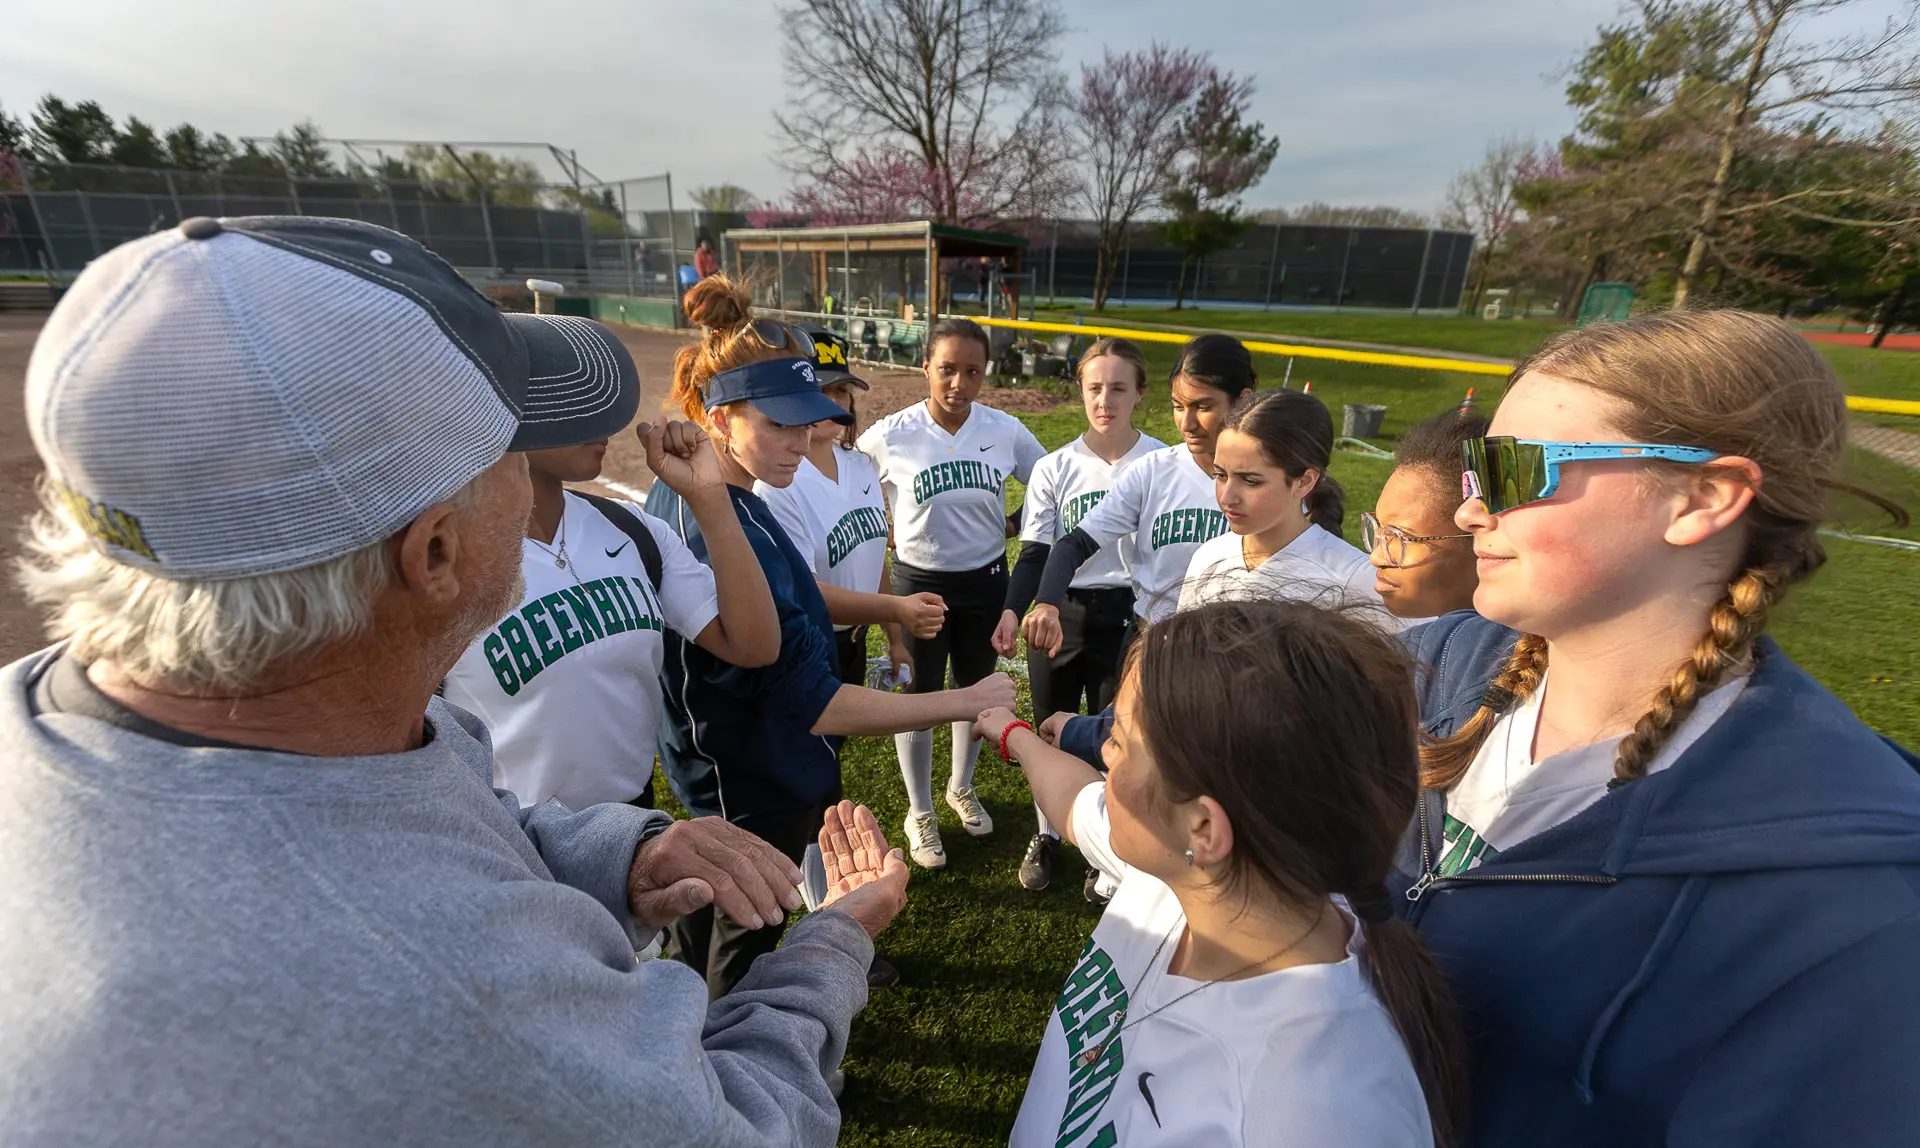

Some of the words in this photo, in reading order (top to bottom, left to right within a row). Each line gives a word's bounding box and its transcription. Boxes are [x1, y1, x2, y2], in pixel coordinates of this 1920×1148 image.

[814, 342, 846, 365] M
[914, 460, 1002, 505] GREENHILLS
[827, 506, 888, 569] GREENHILL
[1152, 508, 1232, 551] GREENHI
[484, 576, 664, 696] GREENHILL
